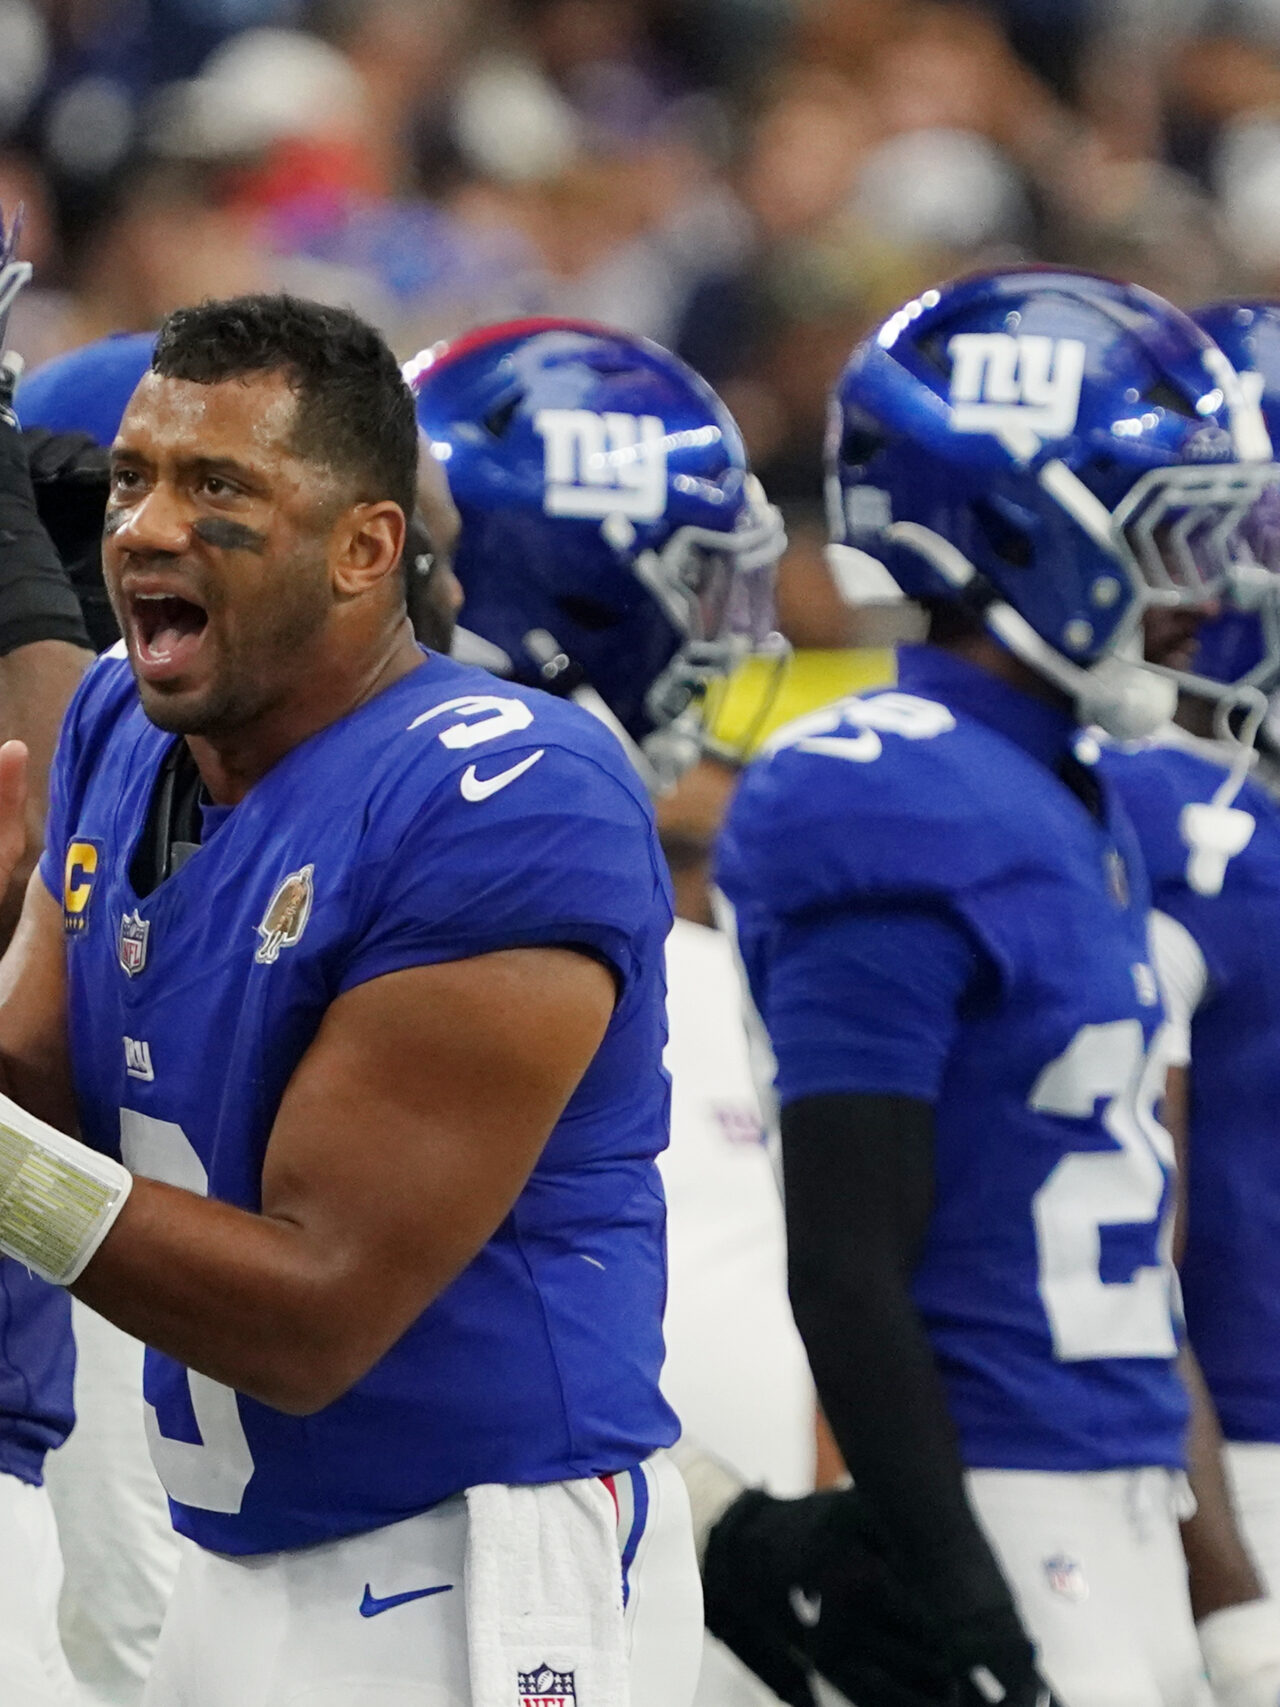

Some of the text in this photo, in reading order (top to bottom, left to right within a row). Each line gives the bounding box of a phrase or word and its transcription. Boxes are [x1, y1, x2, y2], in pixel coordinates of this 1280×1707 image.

[406, 695, 535, 750] 3
[64, 842, 98, 914] C
[122, 942, 141, 965] NFL
